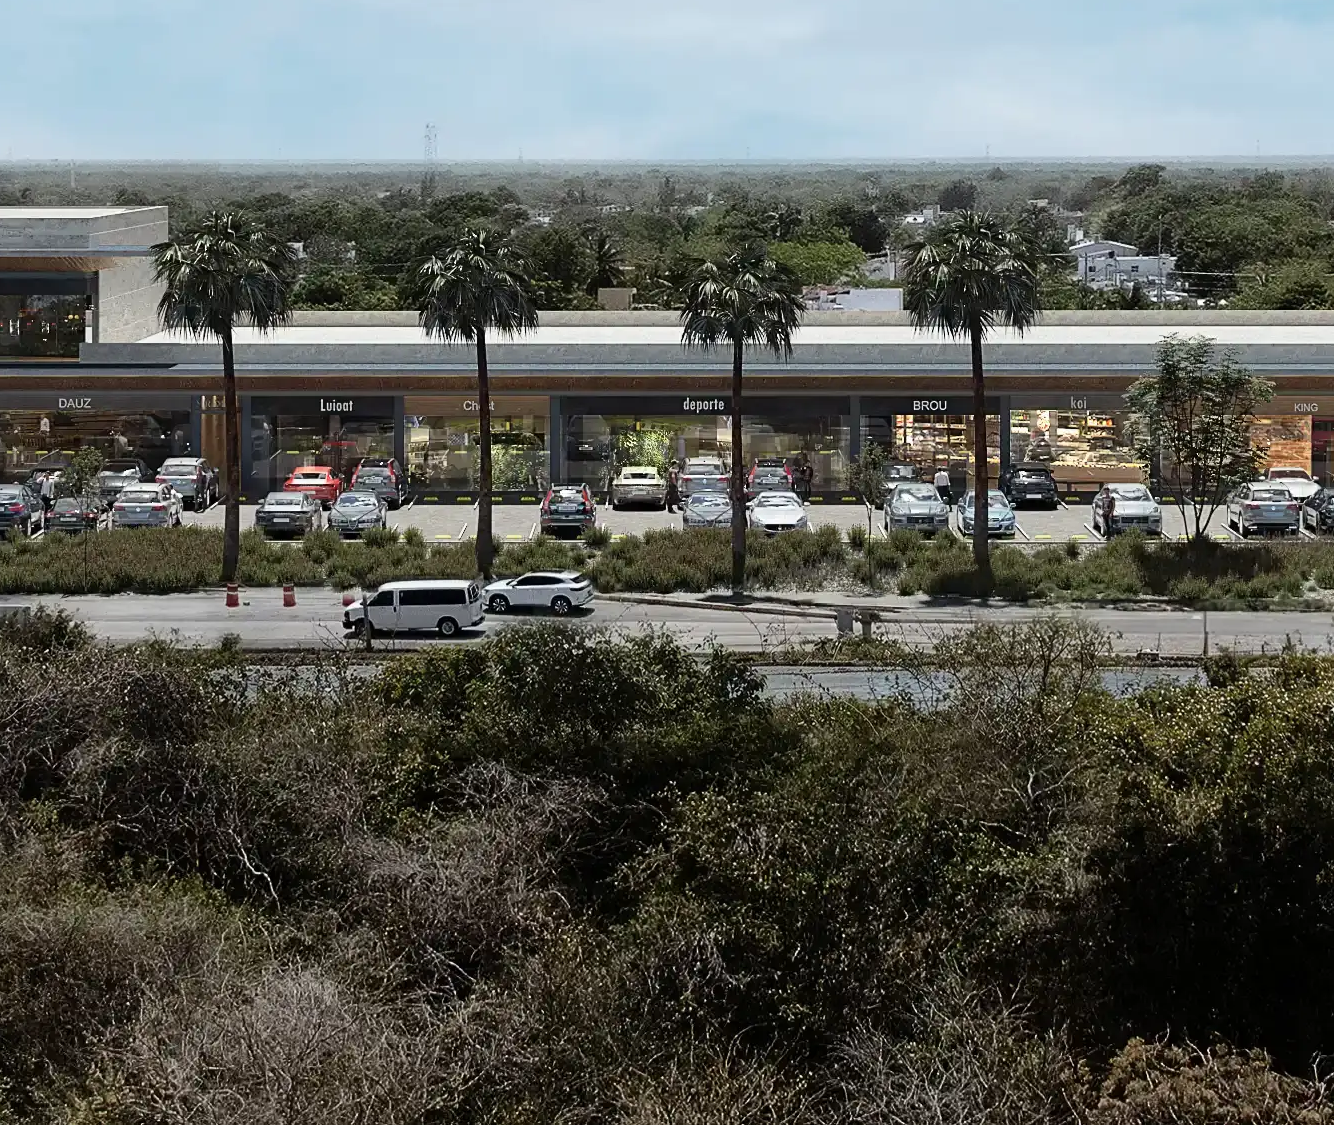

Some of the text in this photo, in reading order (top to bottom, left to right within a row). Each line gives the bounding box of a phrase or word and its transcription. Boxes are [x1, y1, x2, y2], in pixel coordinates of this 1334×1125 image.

[58, 398, 92, 409] DAUZ
[320, 398, 354, 412] Luioat
[683, 397, 725, 413] deporte
[913, 401, 947, 411] BROU
[1070, 396, 1087, 410] koi
[1294, 403, 1319, 412] KING
